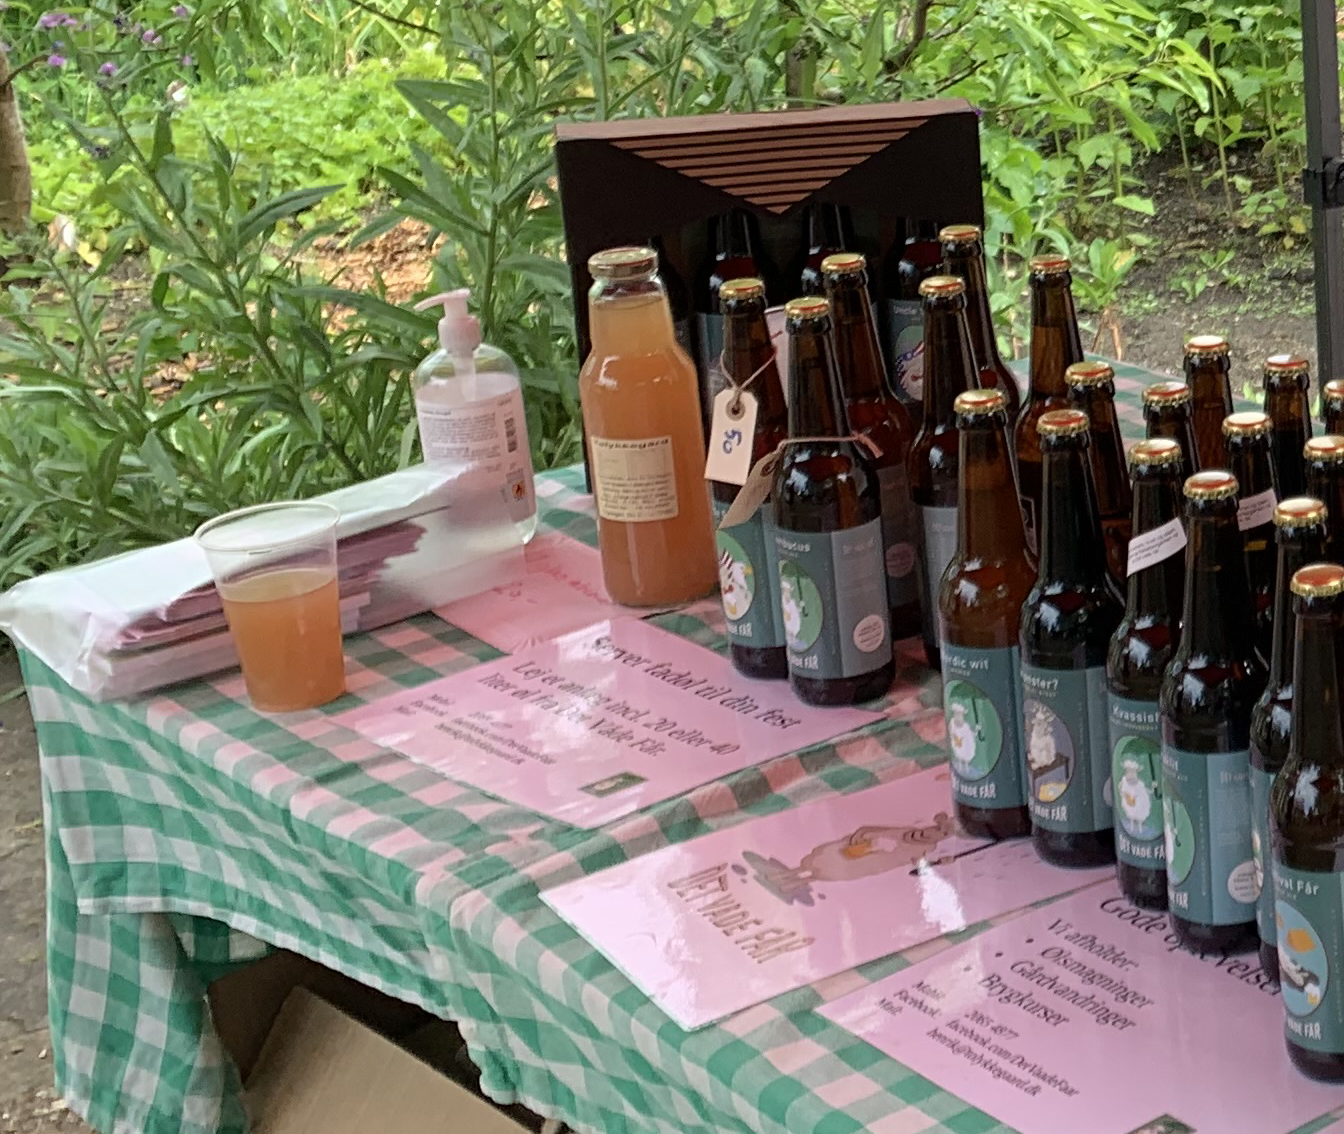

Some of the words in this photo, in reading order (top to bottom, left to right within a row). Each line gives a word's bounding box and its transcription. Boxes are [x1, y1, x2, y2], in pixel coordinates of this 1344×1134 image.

[694, 685, 732, 700] til
[719, 694, 759, 715] din
[754, 709, 802, 729] fest
[642, 718, 677, 732] 20
[667, 729, 712, 746] eller
[710, 743, 740, 755] 40
[1100, 896, 1167, 935] Gode
[979, 972, 1070, 1027] Brygkurser
[1009, 960, 1138, 1031] Gårdvandringer
[1040, 945, 1154, 1009] Ølsmagninger
